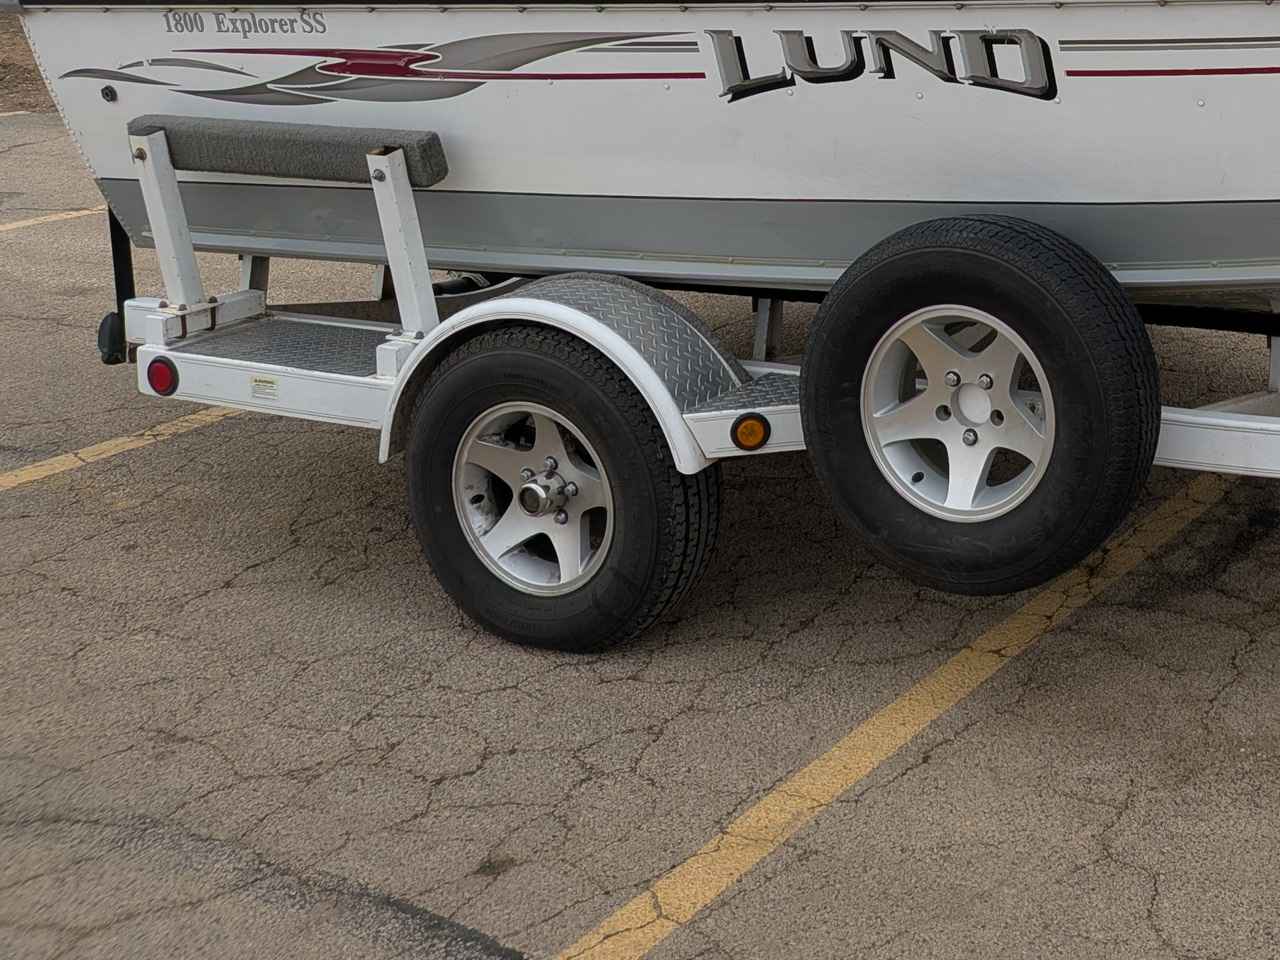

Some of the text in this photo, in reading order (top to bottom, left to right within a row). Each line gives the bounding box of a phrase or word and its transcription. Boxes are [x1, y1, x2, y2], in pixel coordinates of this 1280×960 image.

[162, 10, 327, 39] 1800 Explorer SS
[703, 29, 1058, 103] LUND
